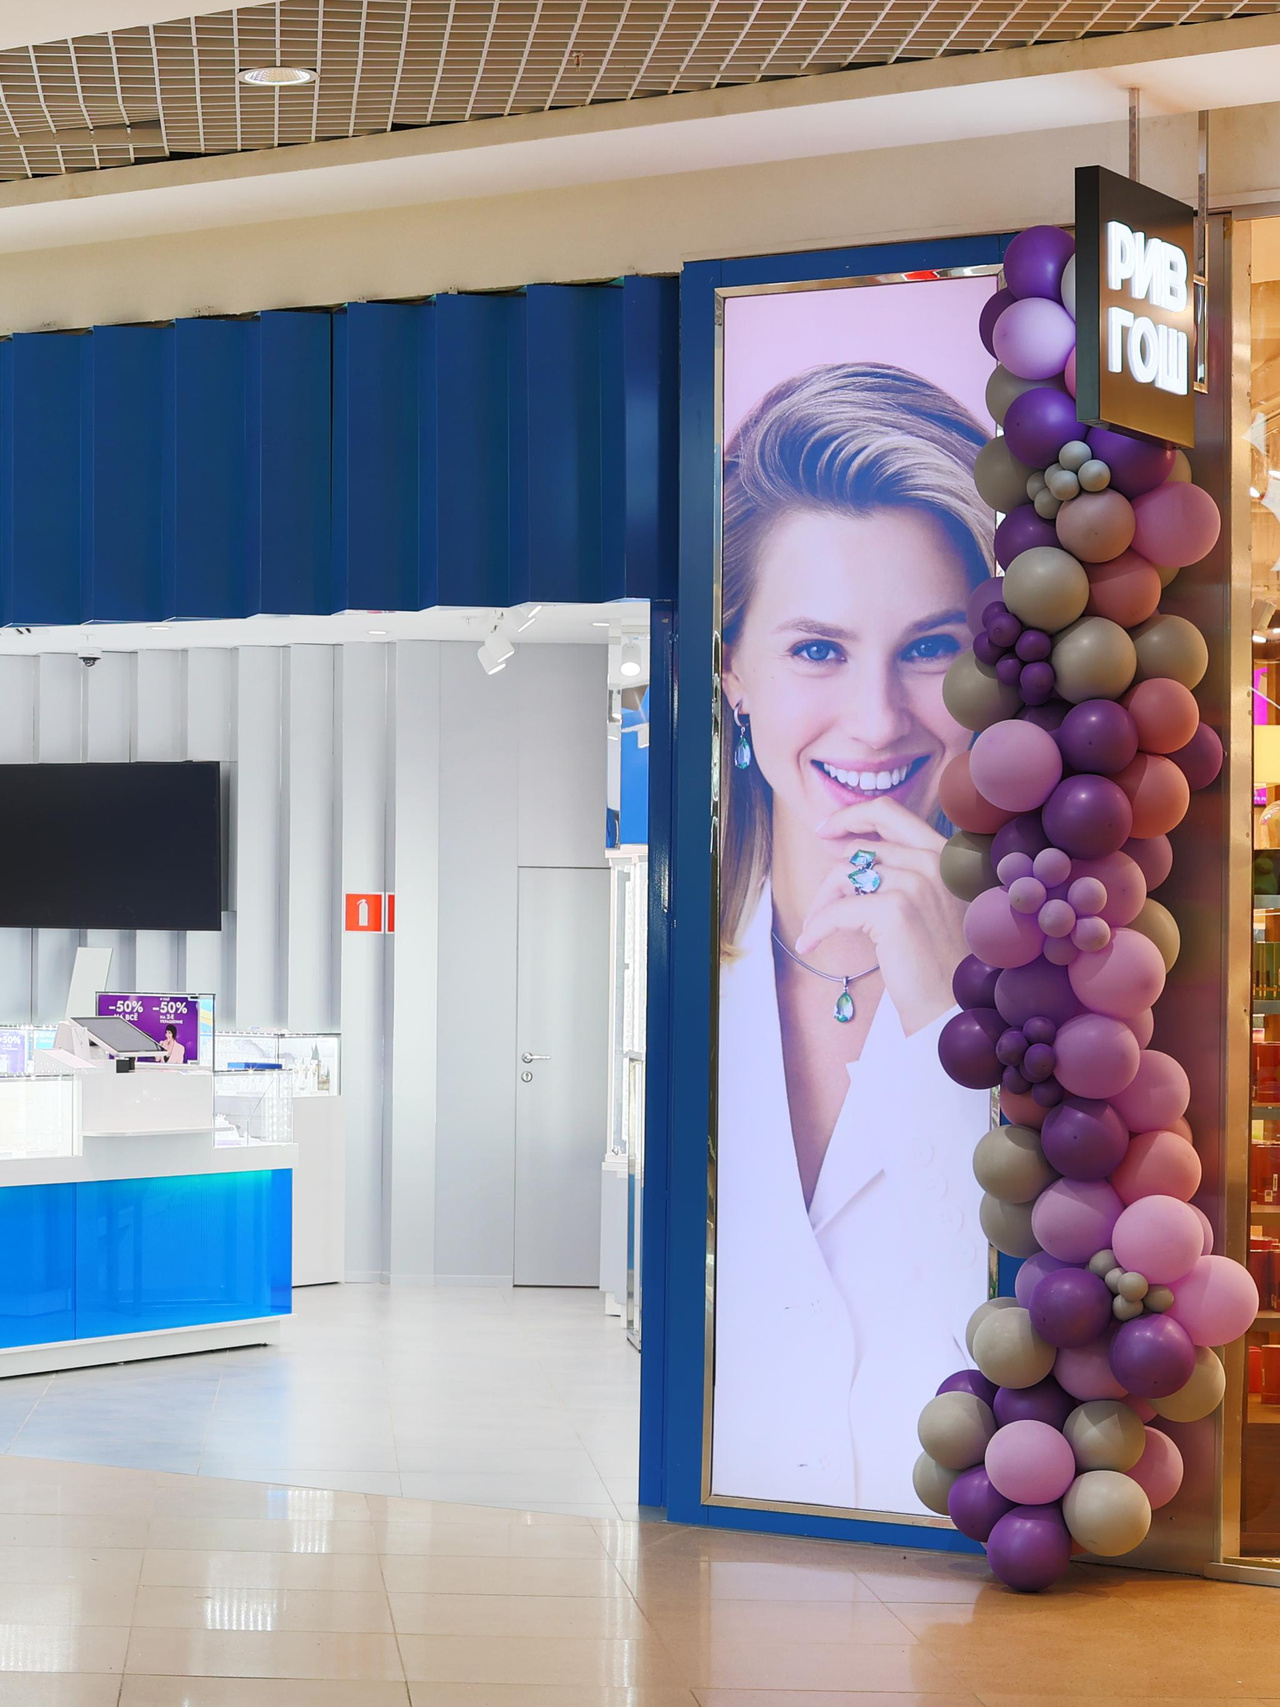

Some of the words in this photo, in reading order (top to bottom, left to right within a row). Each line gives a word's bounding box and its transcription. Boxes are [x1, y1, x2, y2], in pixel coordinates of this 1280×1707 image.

[1106, 220, 1188, 312] РИВ
[1107, 306, 1188, 396] ГОШ
[108, 1000, 143, 1013] -50%
[152, 1001, 188, 1014] -50%
[125, 1013, 138, 1021] ВСЁ
